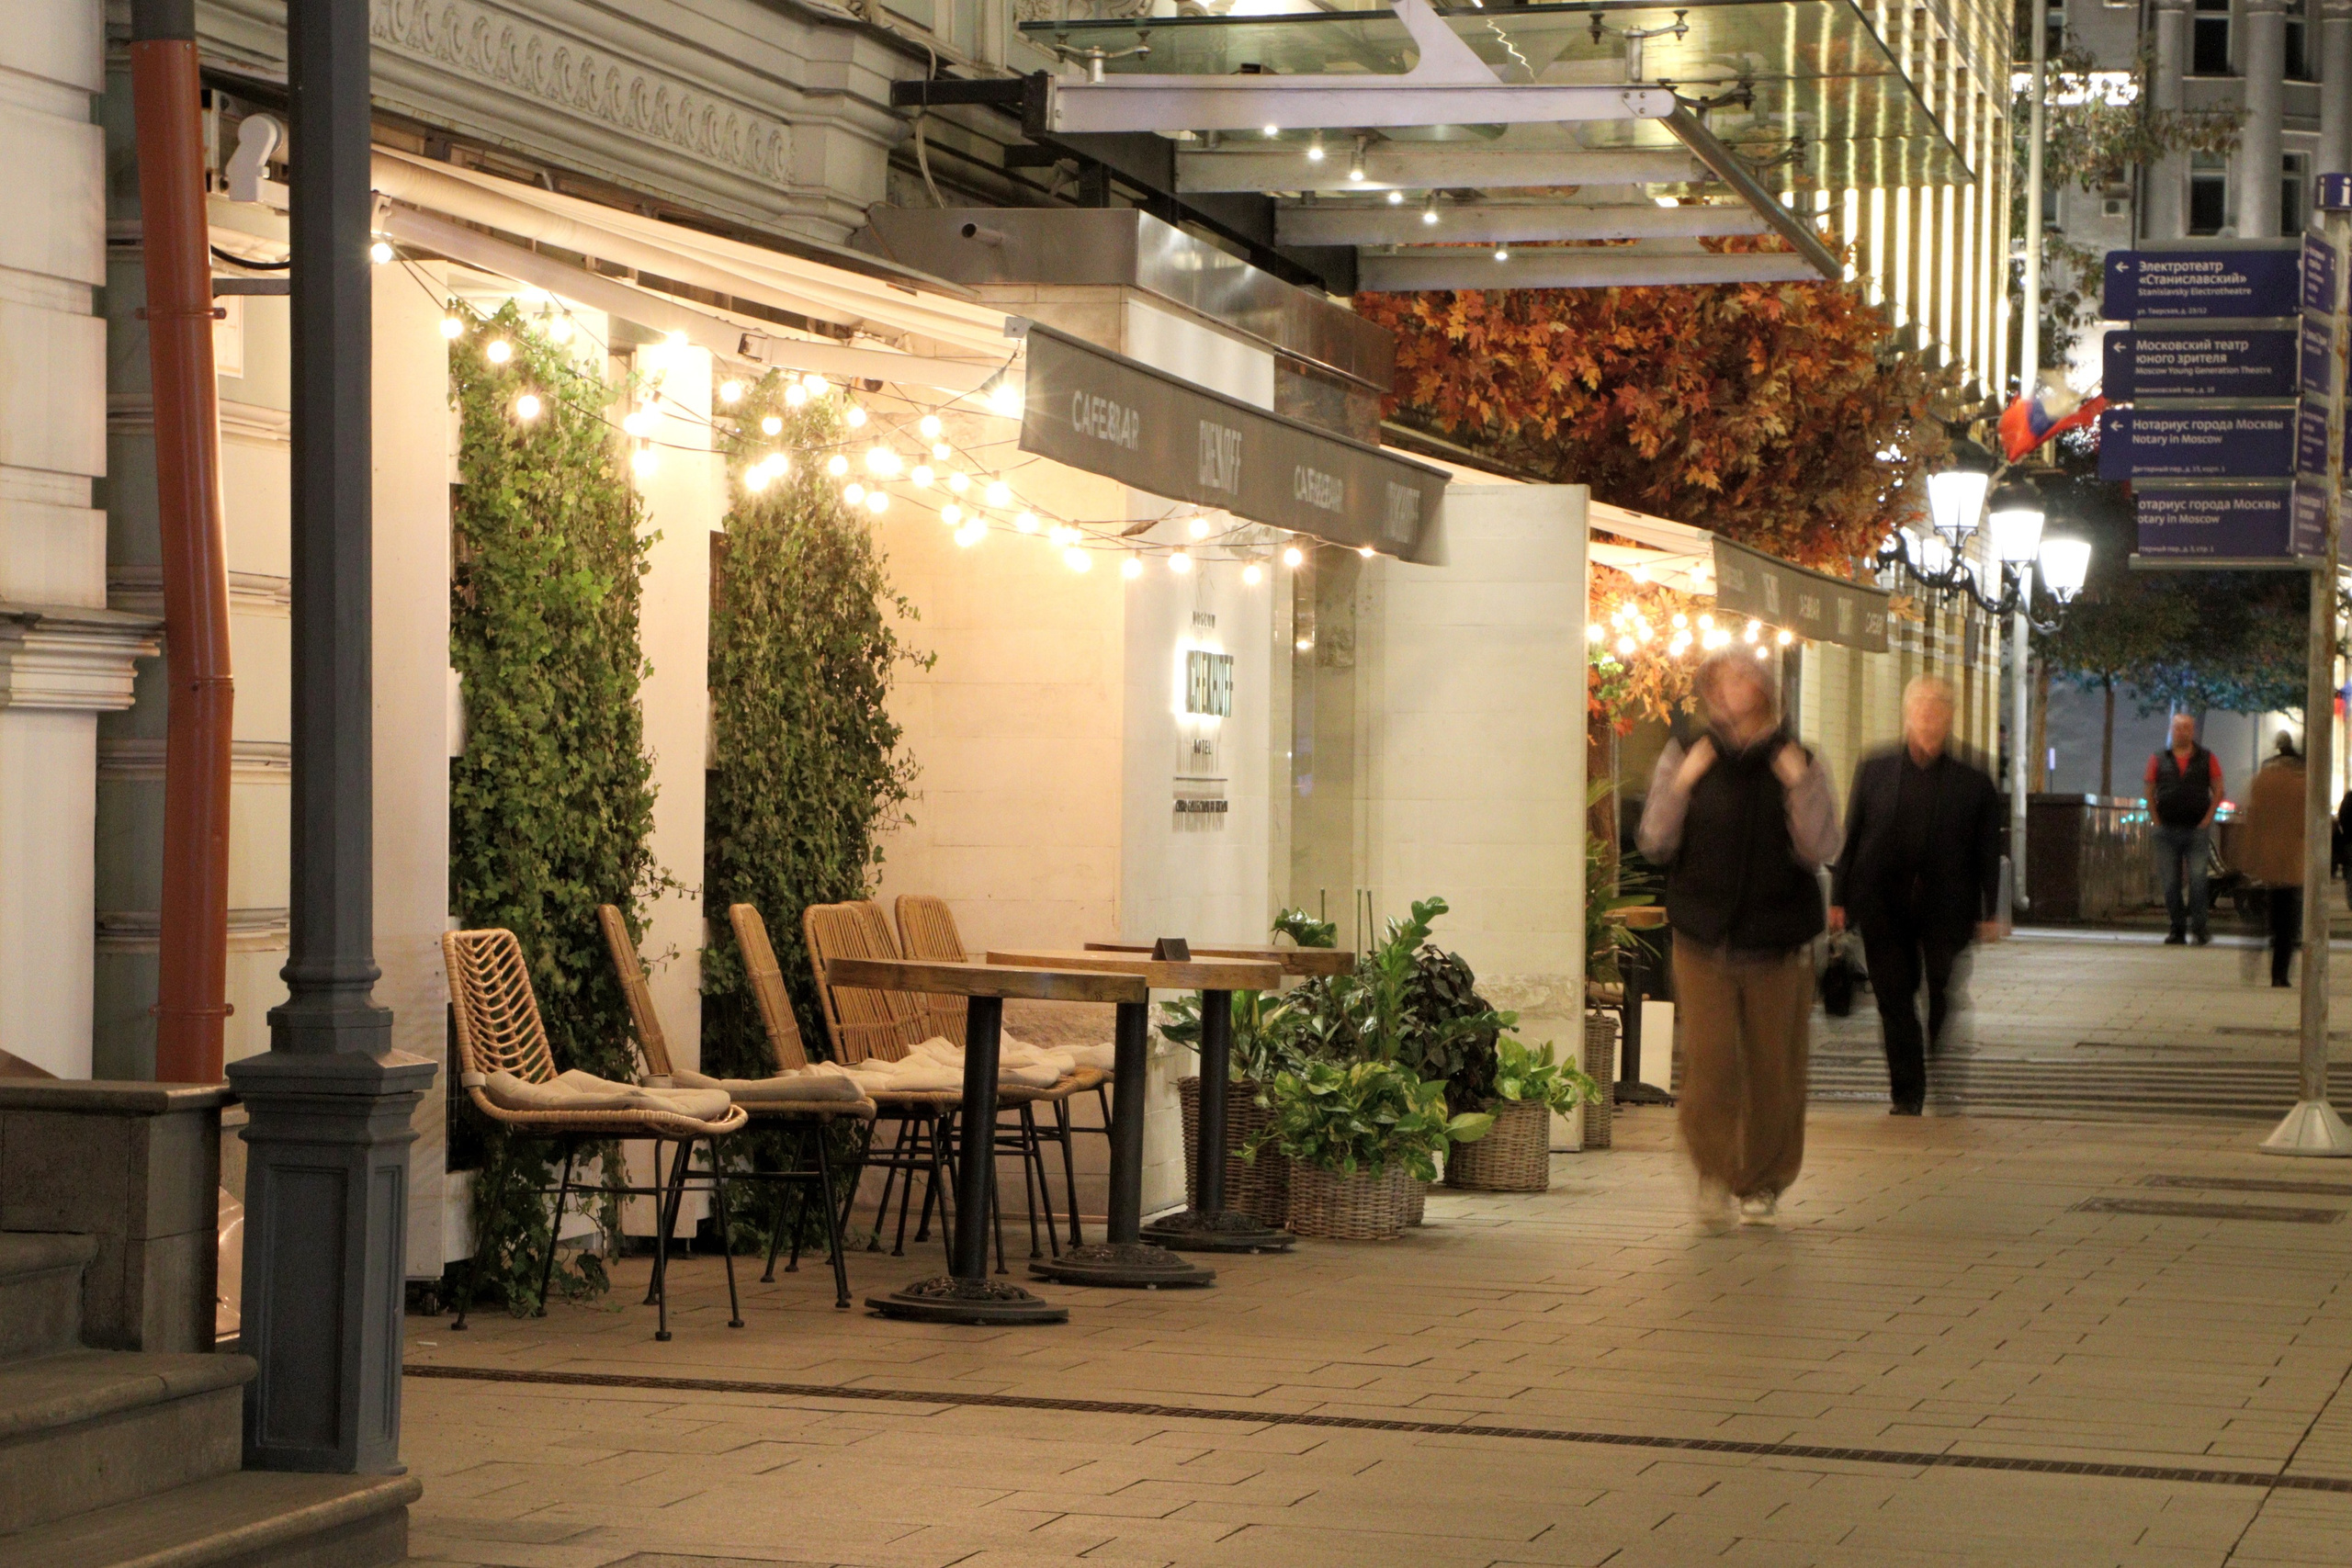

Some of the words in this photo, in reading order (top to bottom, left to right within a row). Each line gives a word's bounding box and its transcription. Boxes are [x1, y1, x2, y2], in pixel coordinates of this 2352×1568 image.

[2139, 261, 2223, 274] Электротеатр
[2139, 273, 2246, 285] «Станиславский»
[2138, 288, 2188, 297] Stanislavsky
[2190, 287, 2251, 296] Electrotheatre
[2136, 339, 2211, 351] Московский
[2214, 341, 2249, 353] театр
[2136, 355, 2175, 364] юного
[2177, 354, 2227, 366] зрителя
[2168, 367, 2193, 376] Young
[2194, 367, 2239, 375] Generation
[2241, 366, 2271, 375] Theatre
[1072, 389, 1139, 452] CAFE&BAR
[2132, 420, 2189, 433] Нотариус
[2191, 421, 2233, 432] города
[2236, 419, 2284, 430] Москвы
[2132, 434, 2167, 446] Notary
[2169, 434, 2179, 444] in
[2181, 434, 2222, 445] Moscow
[2138, 500, 2187, 513] отариус
[2189, 501, 2231, 512] города
[2233, 500, 2282, 511] Москвы
[2137, 514, 2165, 526] otary
[2167, 513, 2177, 525] in
[2179, 514, 2220, 525] Moscow
[1193, 739, 1212, 755] HOTEL
